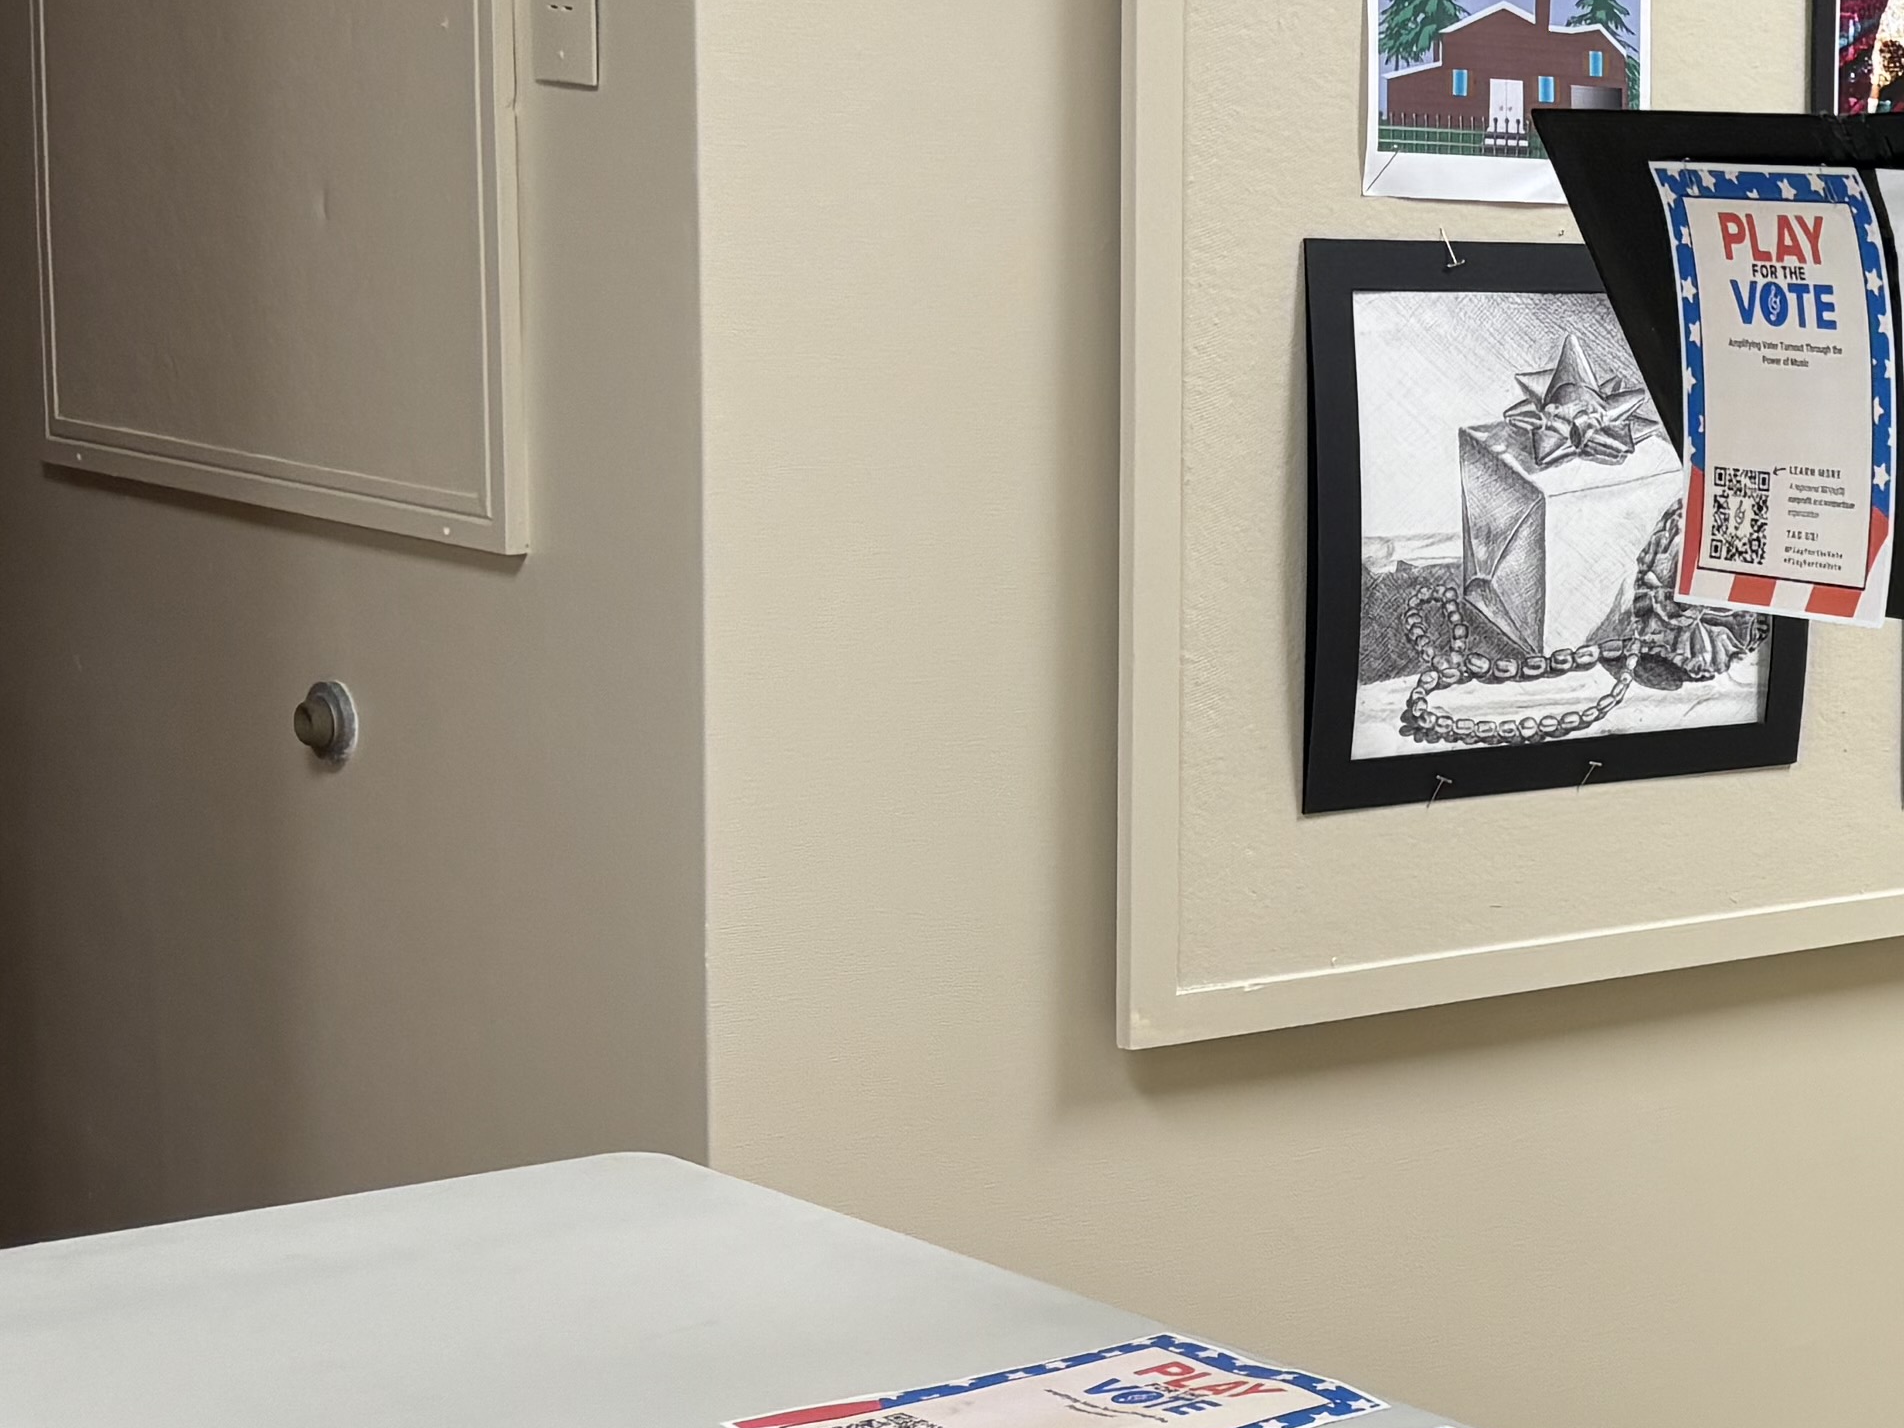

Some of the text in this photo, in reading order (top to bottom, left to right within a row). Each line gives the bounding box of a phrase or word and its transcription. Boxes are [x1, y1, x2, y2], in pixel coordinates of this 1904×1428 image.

[1717, 212, 1824, 265] PLAY
[1752, 263, 1806, 281] FOR THE
[1729, 279, 1838, 330] VOTE
[1083, 1377, 1223, 1416] VOTE
[1133, 1360, 1288, 1398] PLAY
